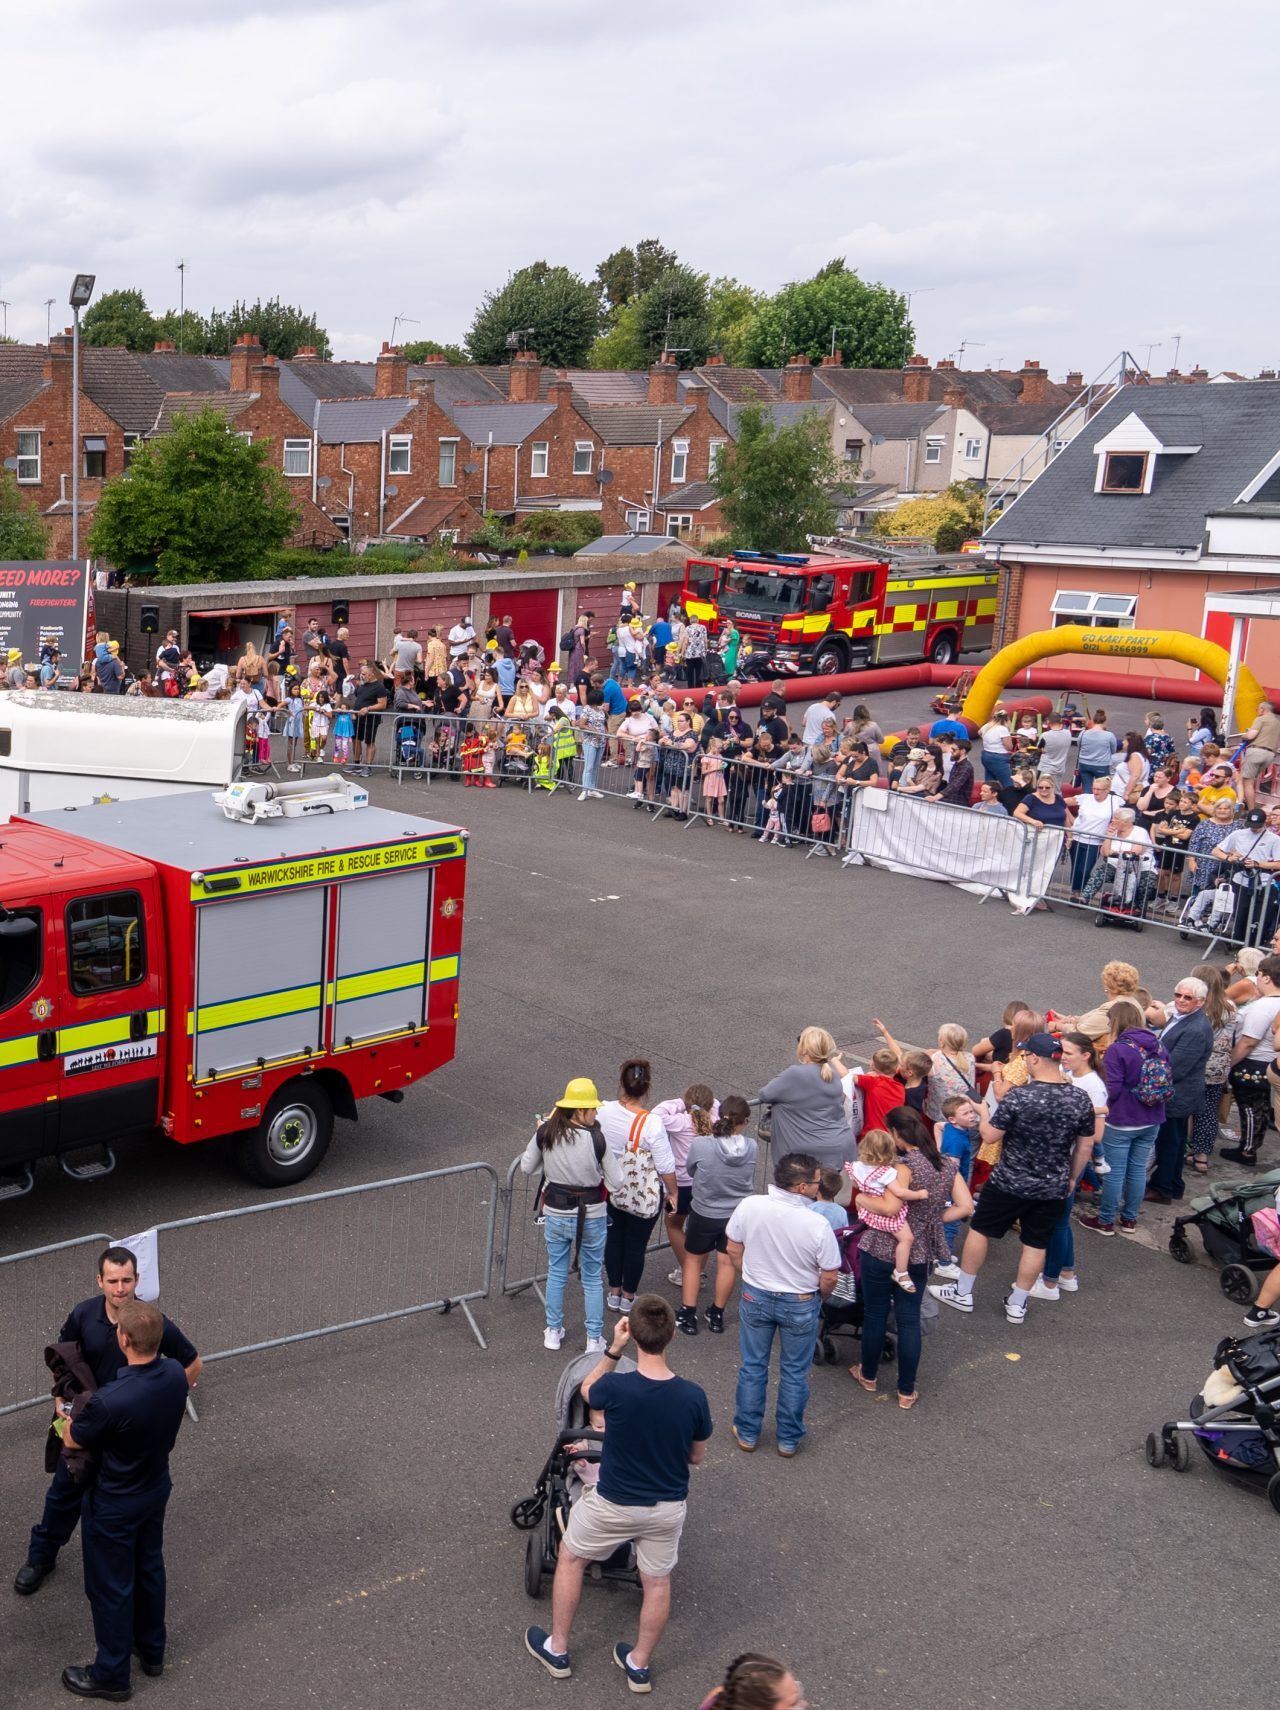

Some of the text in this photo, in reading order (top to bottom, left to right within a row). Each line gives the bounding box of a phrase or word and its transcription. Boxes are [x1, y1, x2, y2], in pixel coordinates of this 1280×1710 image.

[27, 569, 81, 587] MORE?
[735, 611, 761, 620] SCANIA
[1082, 634, 1159, 645] GO KART PARTY
[1082, 643, 1148, 653] 0121 3266999
[248, 847, 418, 886] WARWICKSHIRE FIRE & RESCUE SERVICE
